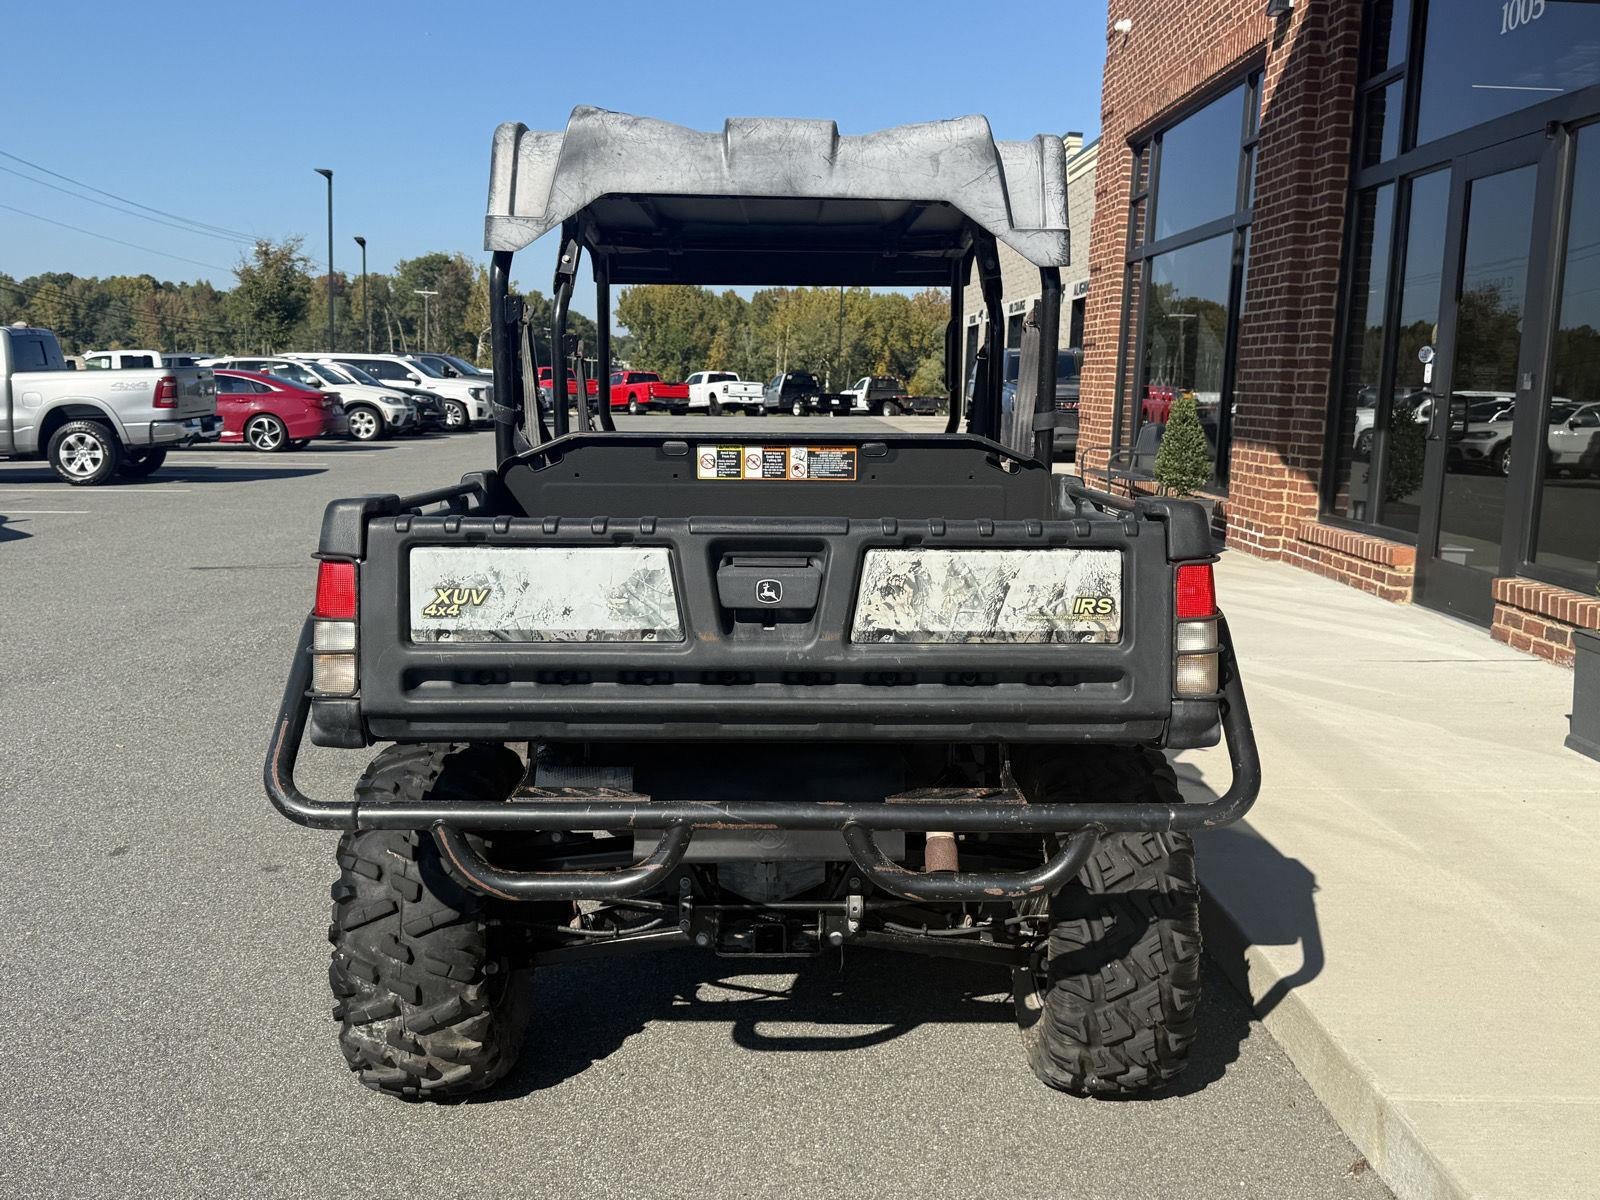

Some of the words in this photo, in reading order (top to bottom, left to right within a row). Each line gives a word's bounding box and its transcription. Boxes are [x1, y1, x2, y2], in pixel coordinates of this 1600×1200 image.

[434, 588, 491, 605] XUV
[423, 604, 460, 616] 4x4
[1073, 597, 1114, 614] IRS
